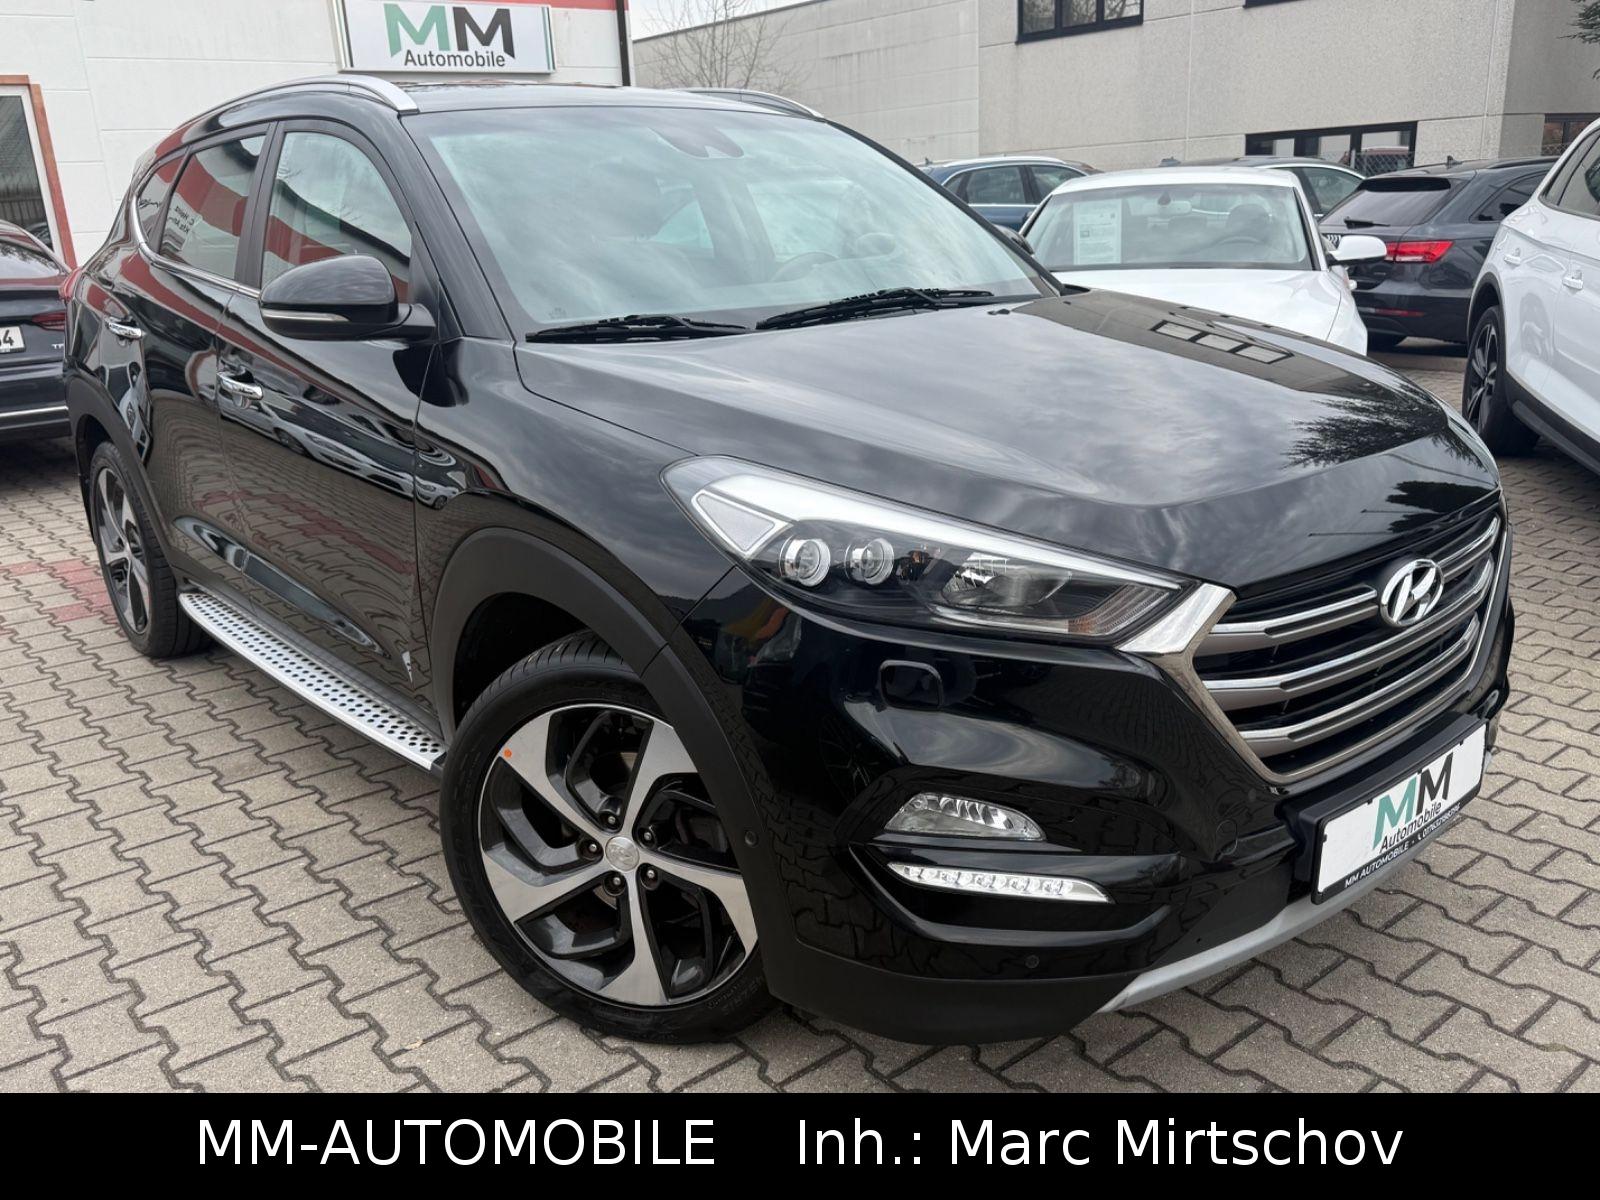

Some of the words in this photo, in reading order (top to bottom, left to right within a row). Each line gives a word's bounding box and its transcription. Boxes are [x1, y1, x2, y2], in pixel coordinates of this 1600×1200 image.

[383, 3, 515, 59] MM
[404, 49, 506, 68] Automobile
[1373, 752, 1454, 851] MM
[1379, 802, 1442, 855] Automobile
[1344, 874, 1360, 888] MM
[1360, 841, 1410, 878] AUTOMOBILE
